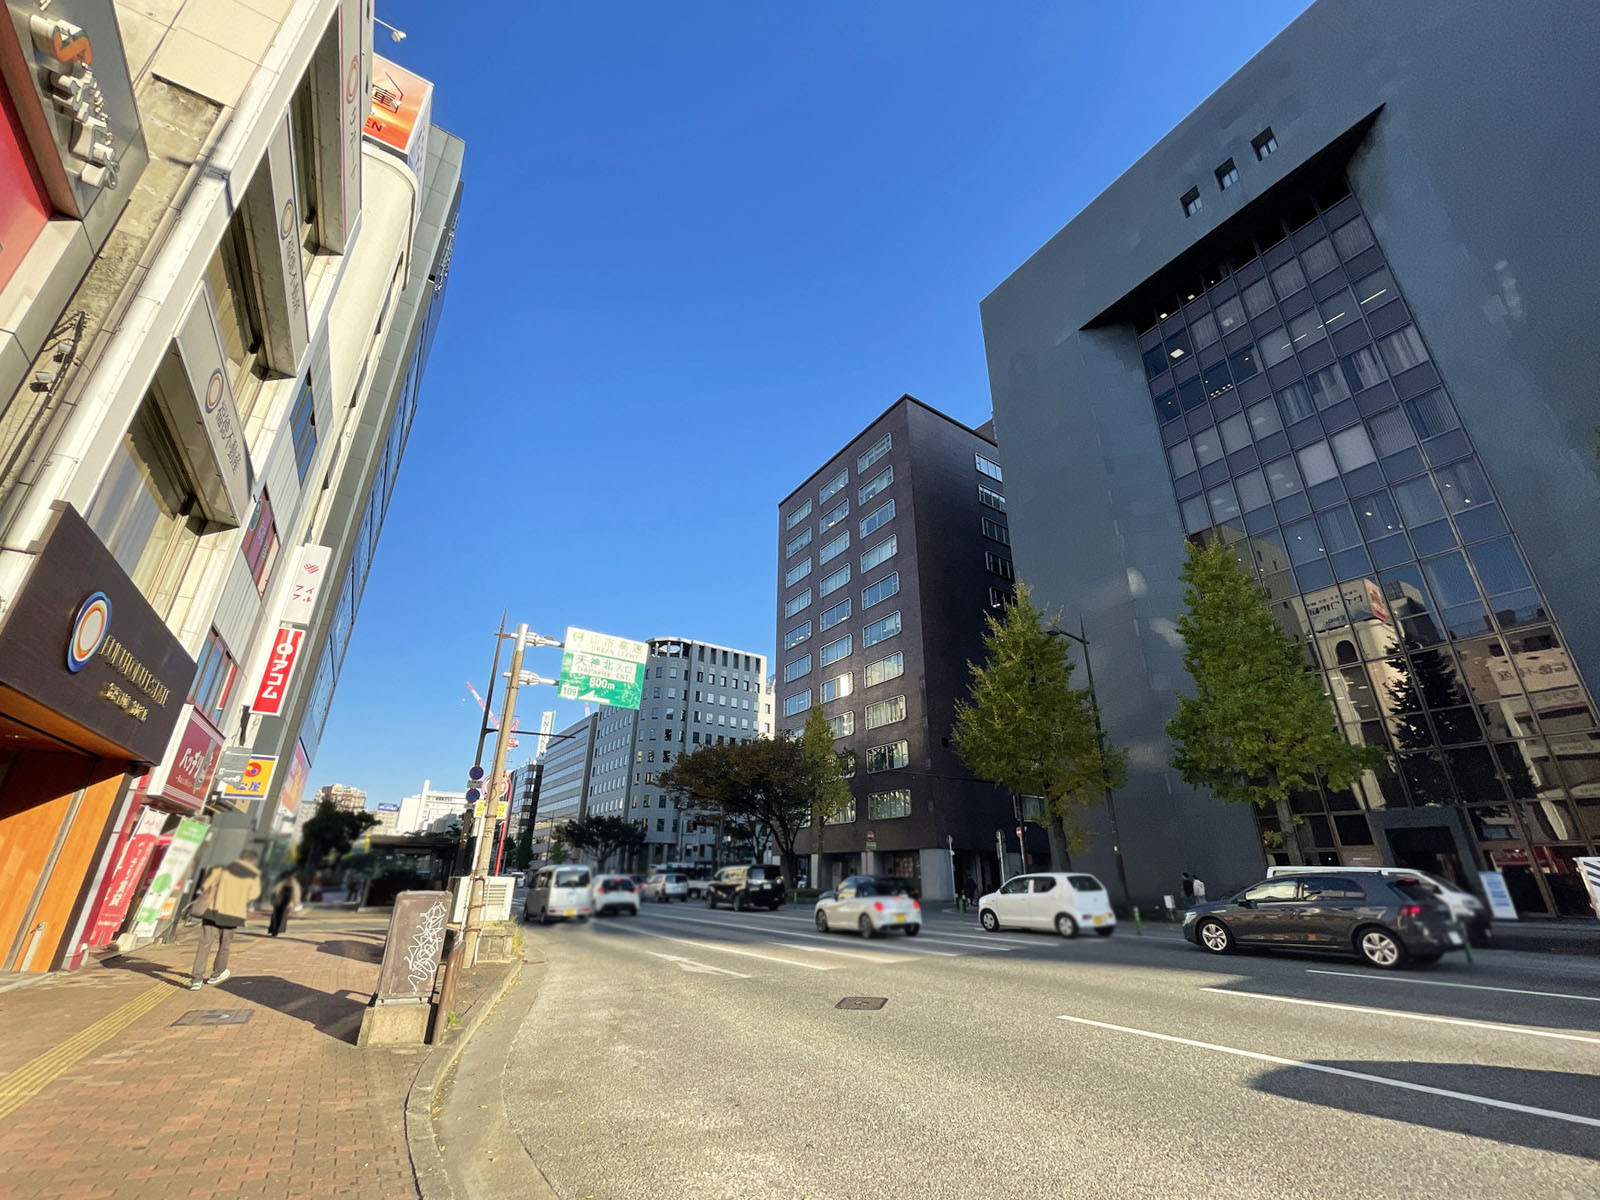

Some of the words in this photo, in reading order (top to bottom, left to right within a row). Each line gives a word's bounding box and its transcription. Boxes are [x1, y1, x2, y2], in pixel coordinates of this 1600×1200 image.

[261, 659, 288, 699] アコム
[575, 654, 633, 674] 天神北入口
